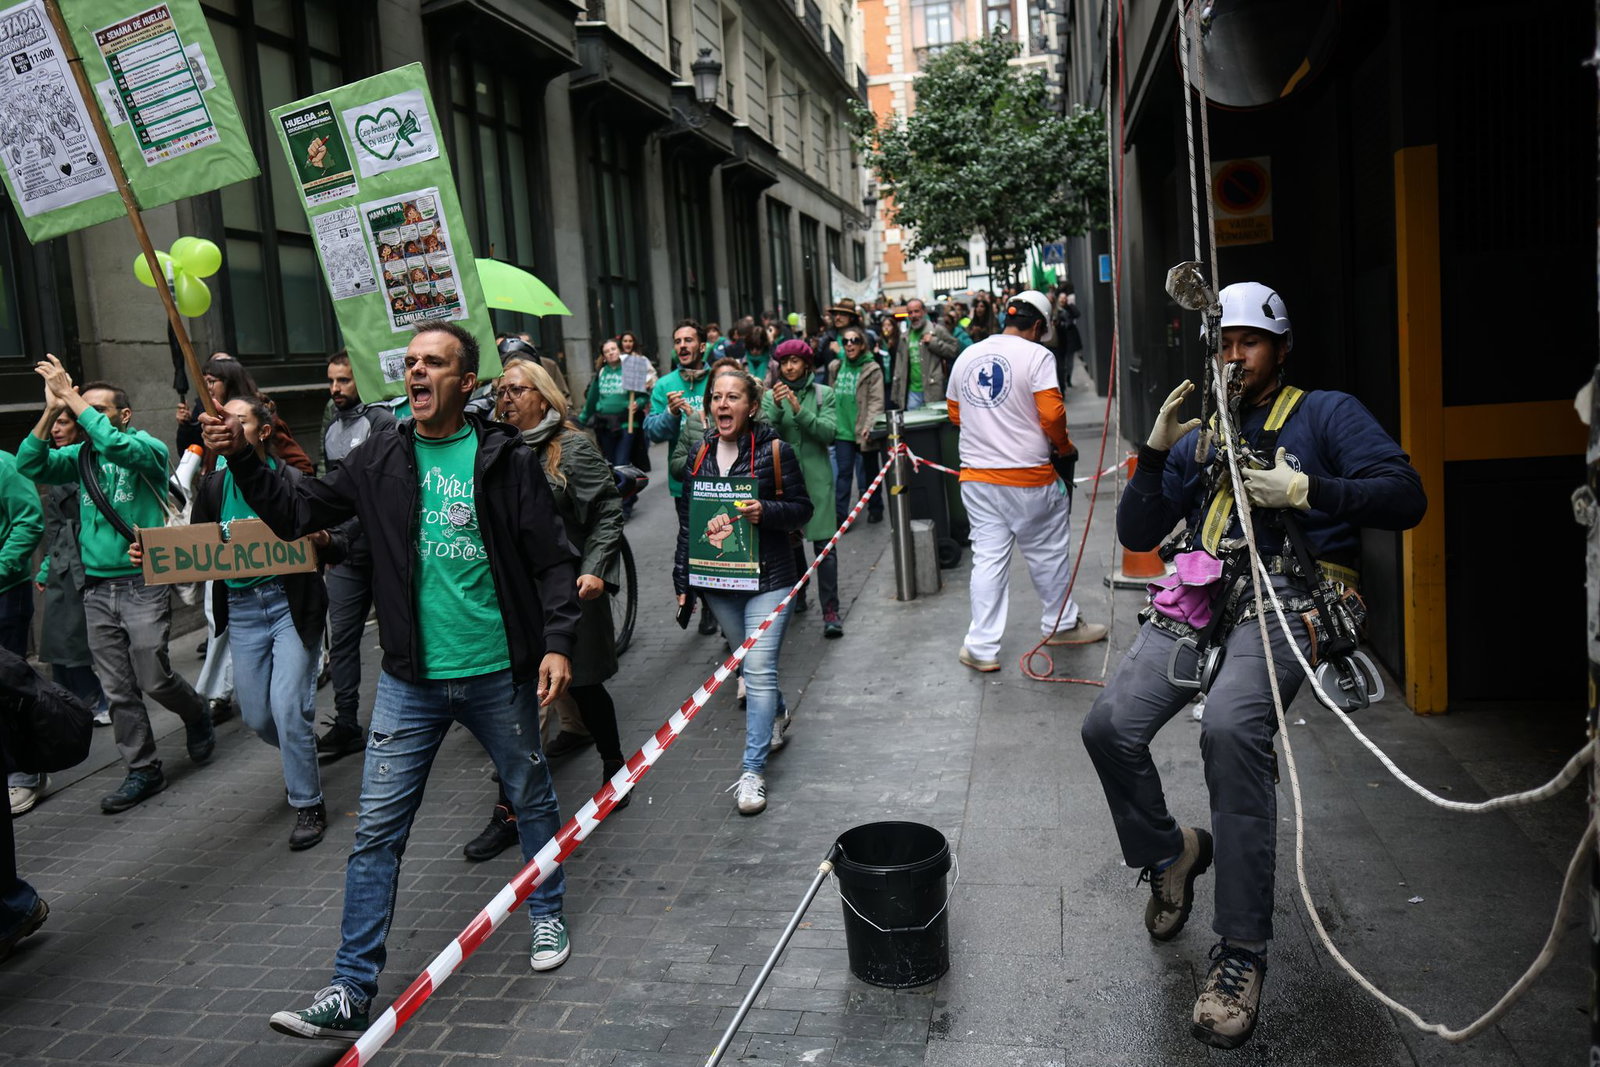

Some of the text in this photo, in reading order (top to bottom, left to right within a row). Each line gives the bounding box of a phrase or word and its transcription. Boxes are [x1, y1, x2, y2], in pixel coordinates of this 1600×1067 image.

[107, 24, 132, 40] SEMANA
[133, 19, 142, 30] DE
[142, 10, 168, 26] HUELGA
[30, 48, 55, 64] 11:00h
[285, 112, 317, 129] HUELGA
[386, 120, 400, 129] Vives
[369, 133, 395, 148] EN HUELGA
[436, 473, 475, 498] PÚBLI
[694, 481, 732, 492] HUELGA
[149, 541, 307, 574] EDUCACION
[425, 540, 488, 561] TOD@S
